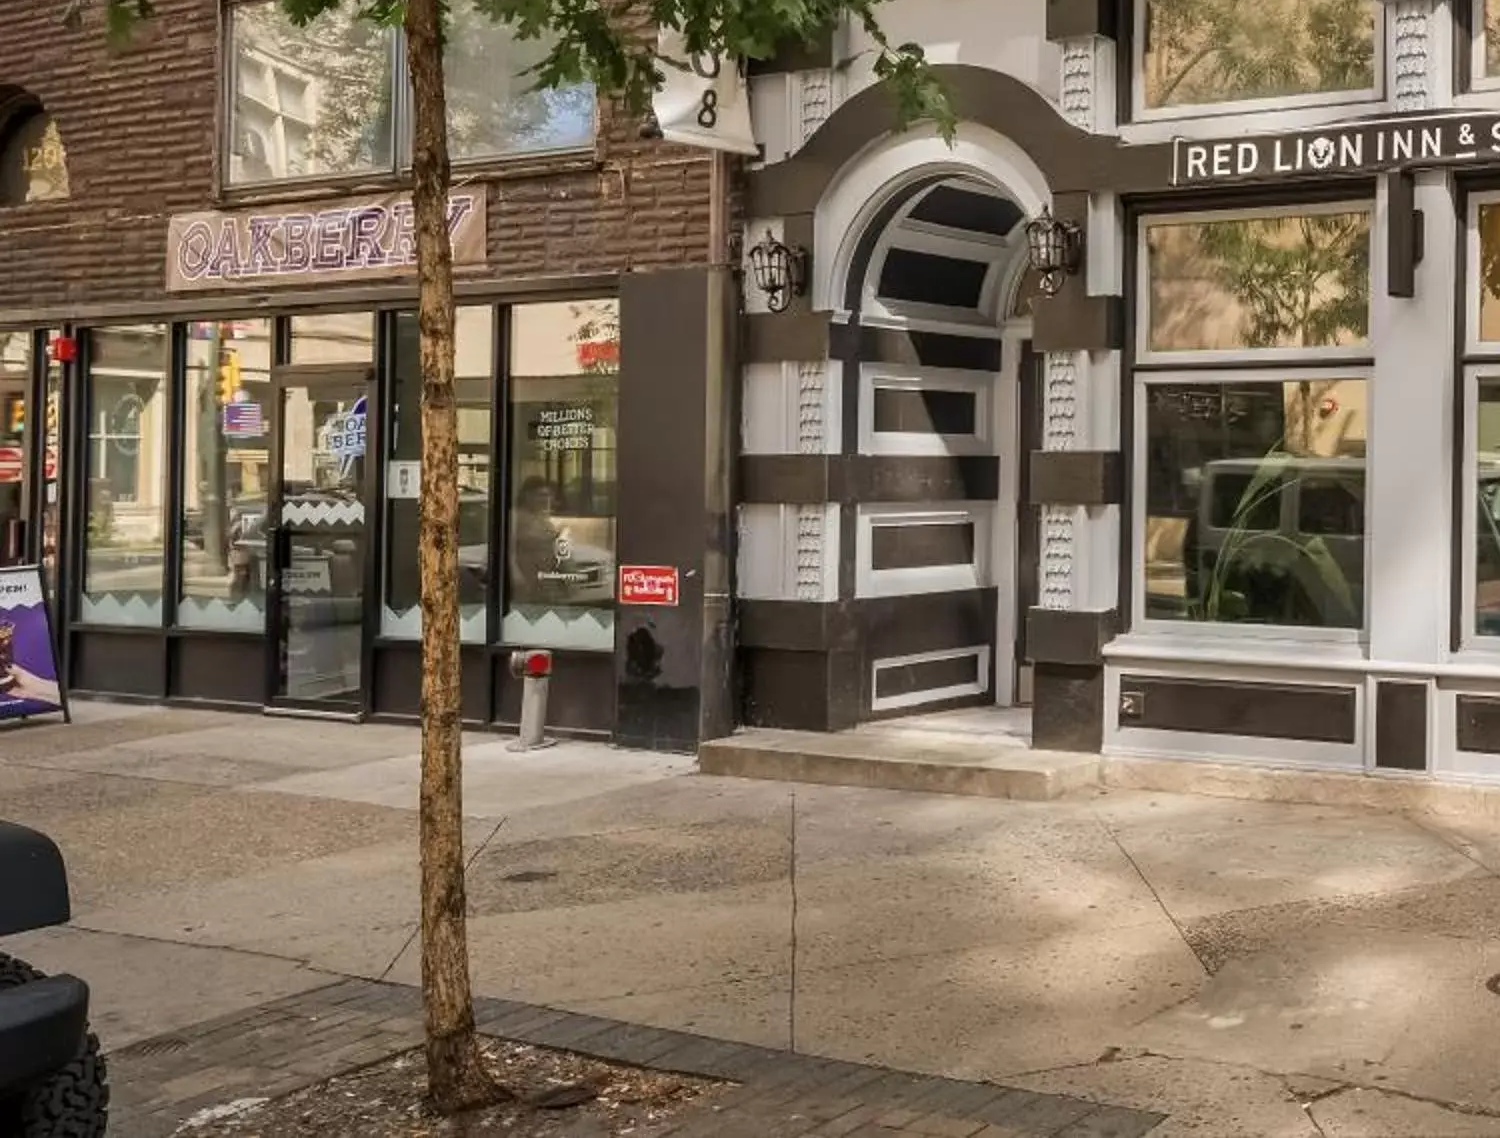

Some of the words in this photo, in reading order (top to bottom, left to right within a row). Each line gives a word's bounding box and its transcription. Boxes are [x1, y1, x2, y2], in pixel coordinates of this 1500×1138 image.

[1187, 142, 1259, 178] RED
[1273, 133, 1363, 172] LION
[1377, 127, 1441, 161] INN
[1456, 123, 1477, 150] &
[540, 408, 593, 423] MILLIONS
[553, 422, 593, 437] BETTER
